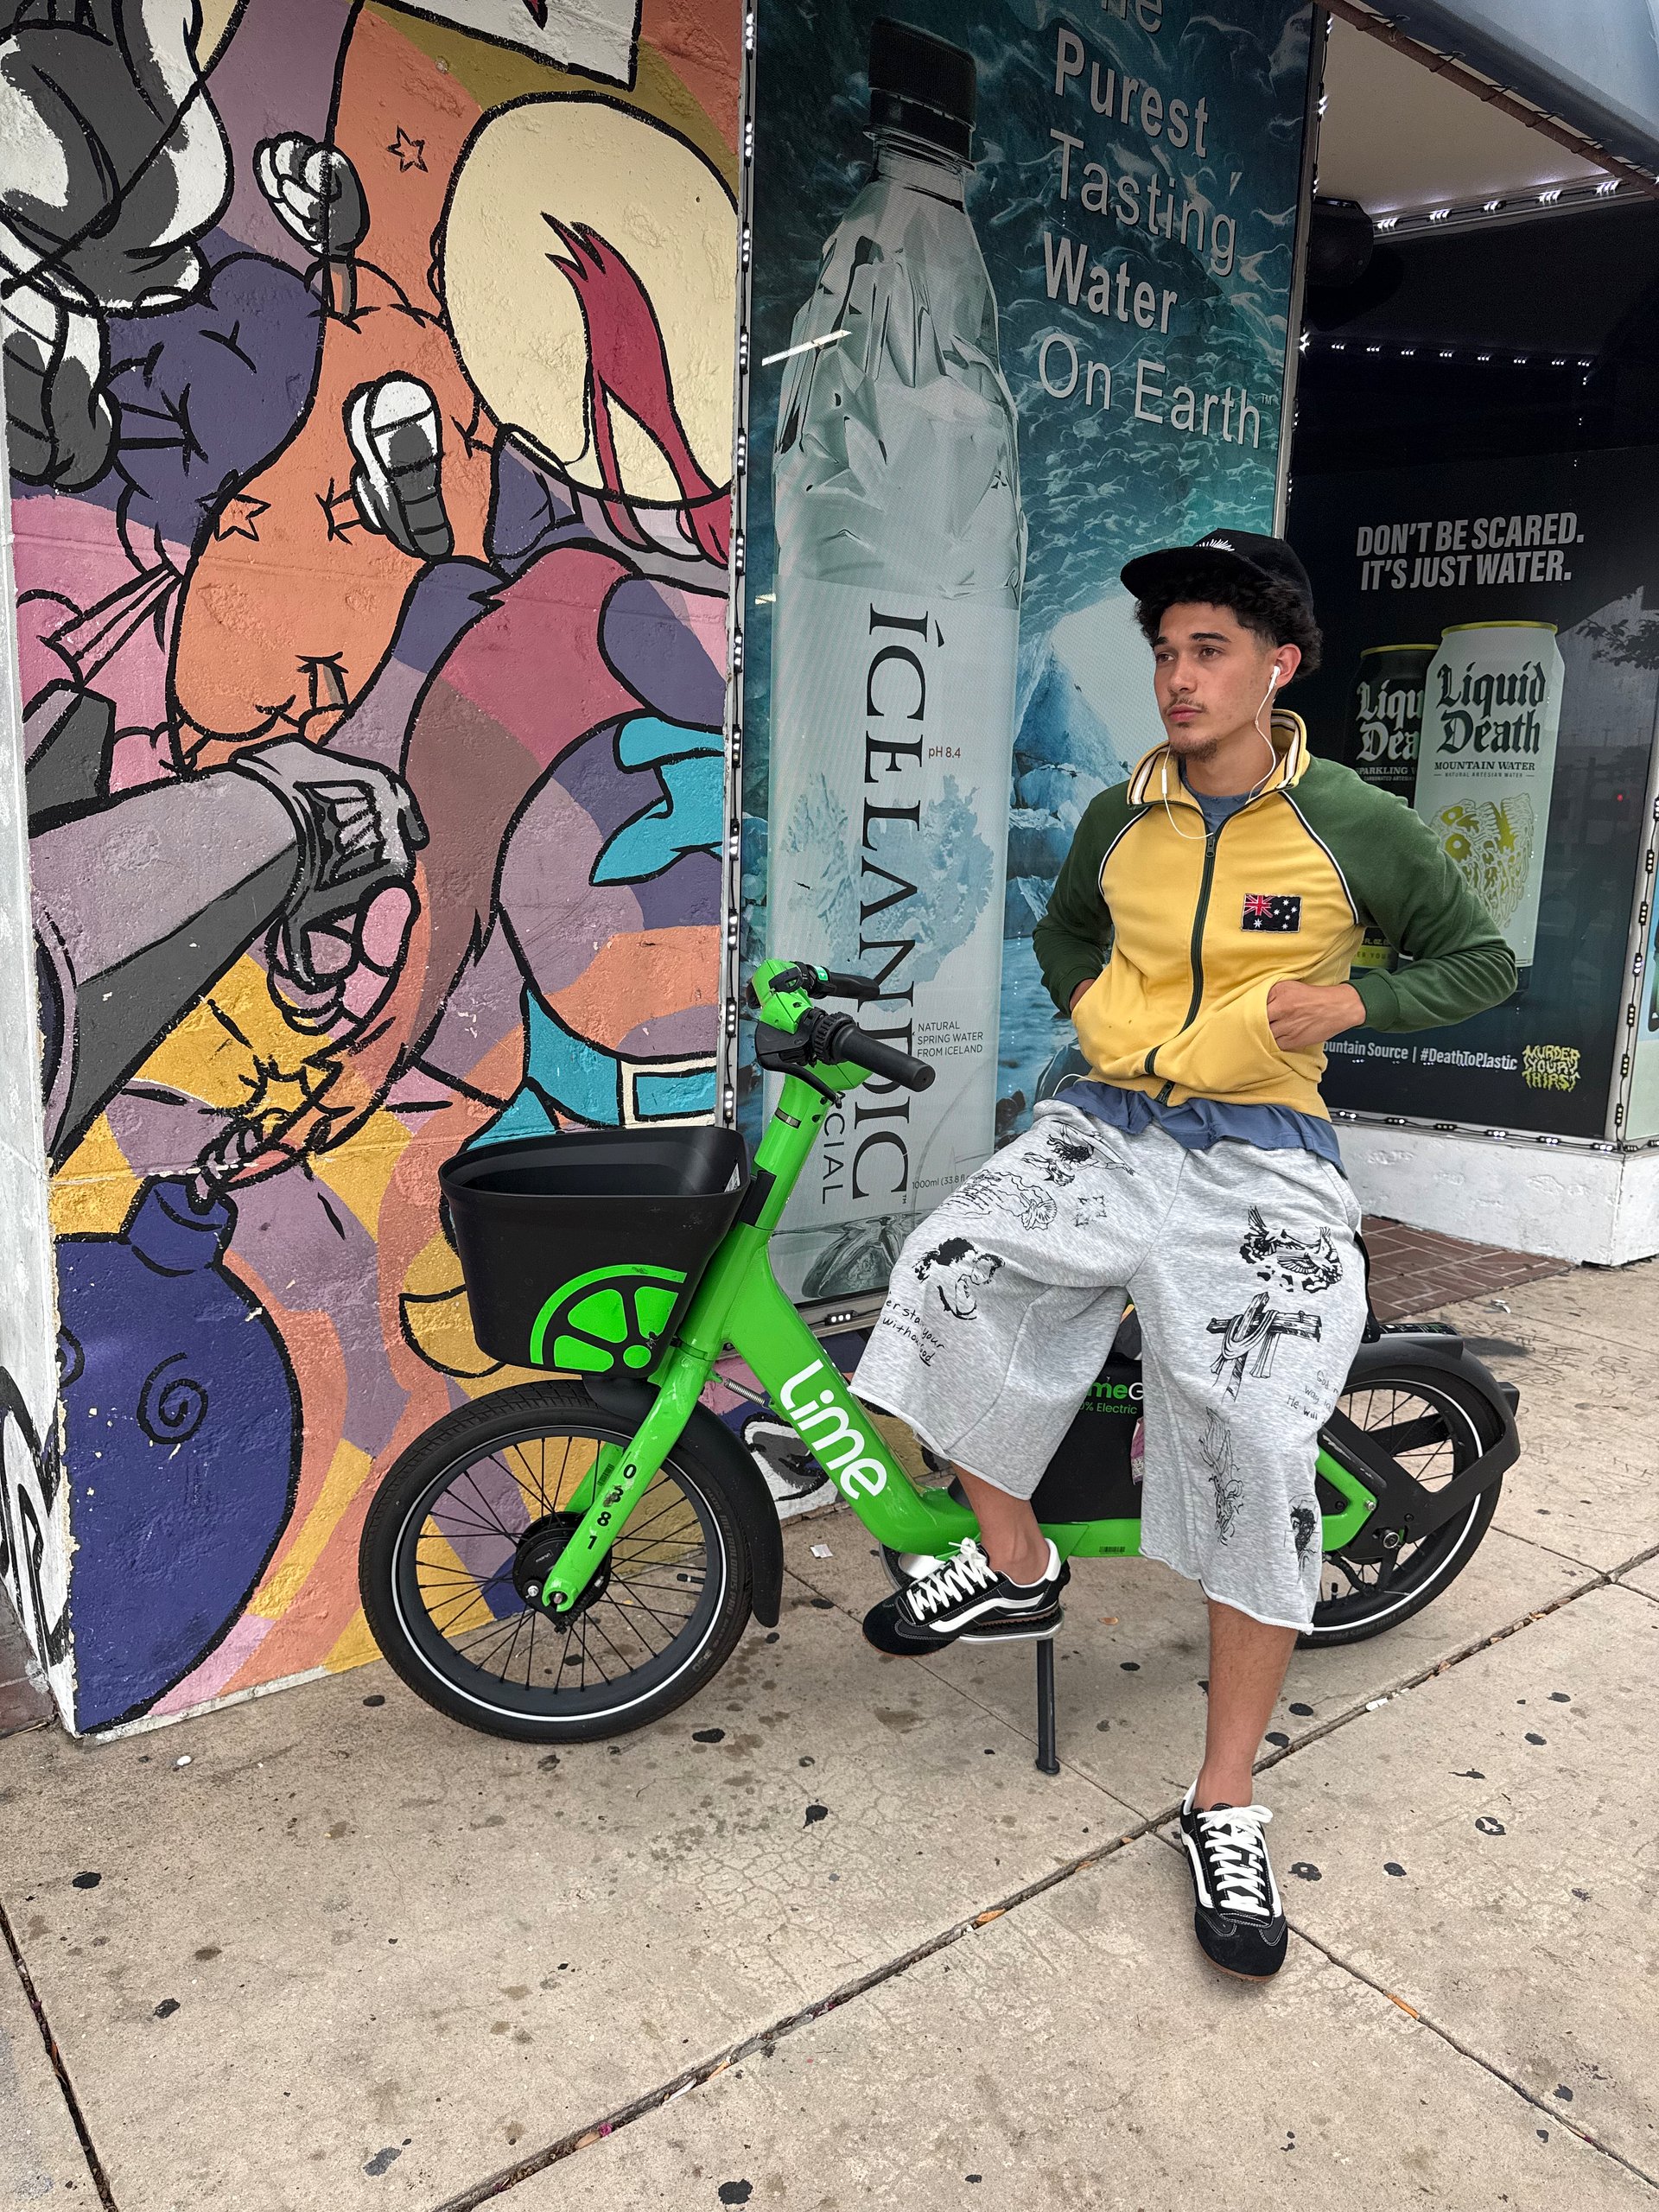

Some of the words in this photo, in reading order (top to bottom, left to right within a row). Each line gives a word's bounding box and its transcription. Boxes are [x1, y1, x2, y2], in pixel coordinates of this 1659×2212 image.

[1055, 27, 1210, 158] Purest
[1050, 129, 1236, 276] Tasting
[1044, 231, 1178, 334] Water
[1039, 333, 1112, 410] On
[1356, 522, 1433, 556] DON'T
[1434, 519, 1469, 552] BE
[1471, 512, 1585, 550] SCARED.
[1361, 558, 1408, 591] IT'S
[1409, 556, 1473, 588] JUST
[1476, 550, 1572, 585] WATER.
[1436, 661, 1546, 720] Liquid
[1436, 709, 1541, 754] Death
[928, 746, 944, 759] pH
[945, 747, 961, 759] 8.4
[1433, 761, 1496, 771] MOUNTAIN
[1497, 761, 1535, 771] WATER
[917, 1034, 950, 1046] SPRING
[952, 1032, 983, 1043] WATER
[918, 1020, 961, 1033] NATURAL
[917, 1046, 943, 1058] FROM
[944, 1045, 983, 1056] ICELAND
[1367, 1042, 1408, 1060] Source
[1420, 1047, 1518, 1071] #DeathToPlastic
[1522, 1045, 1581, 1063] MURDER
[1525, 1058, 1574, 1075] YOUR
[1522, 1068, 1581, 1093] THIRST
[912, 1177, 939, 1190] 1000ml
[921, 1327, 945, 1349] your
[1096, 1402, 1138, 1414] Electric
[779, 1358, 887, 1501] Lime
